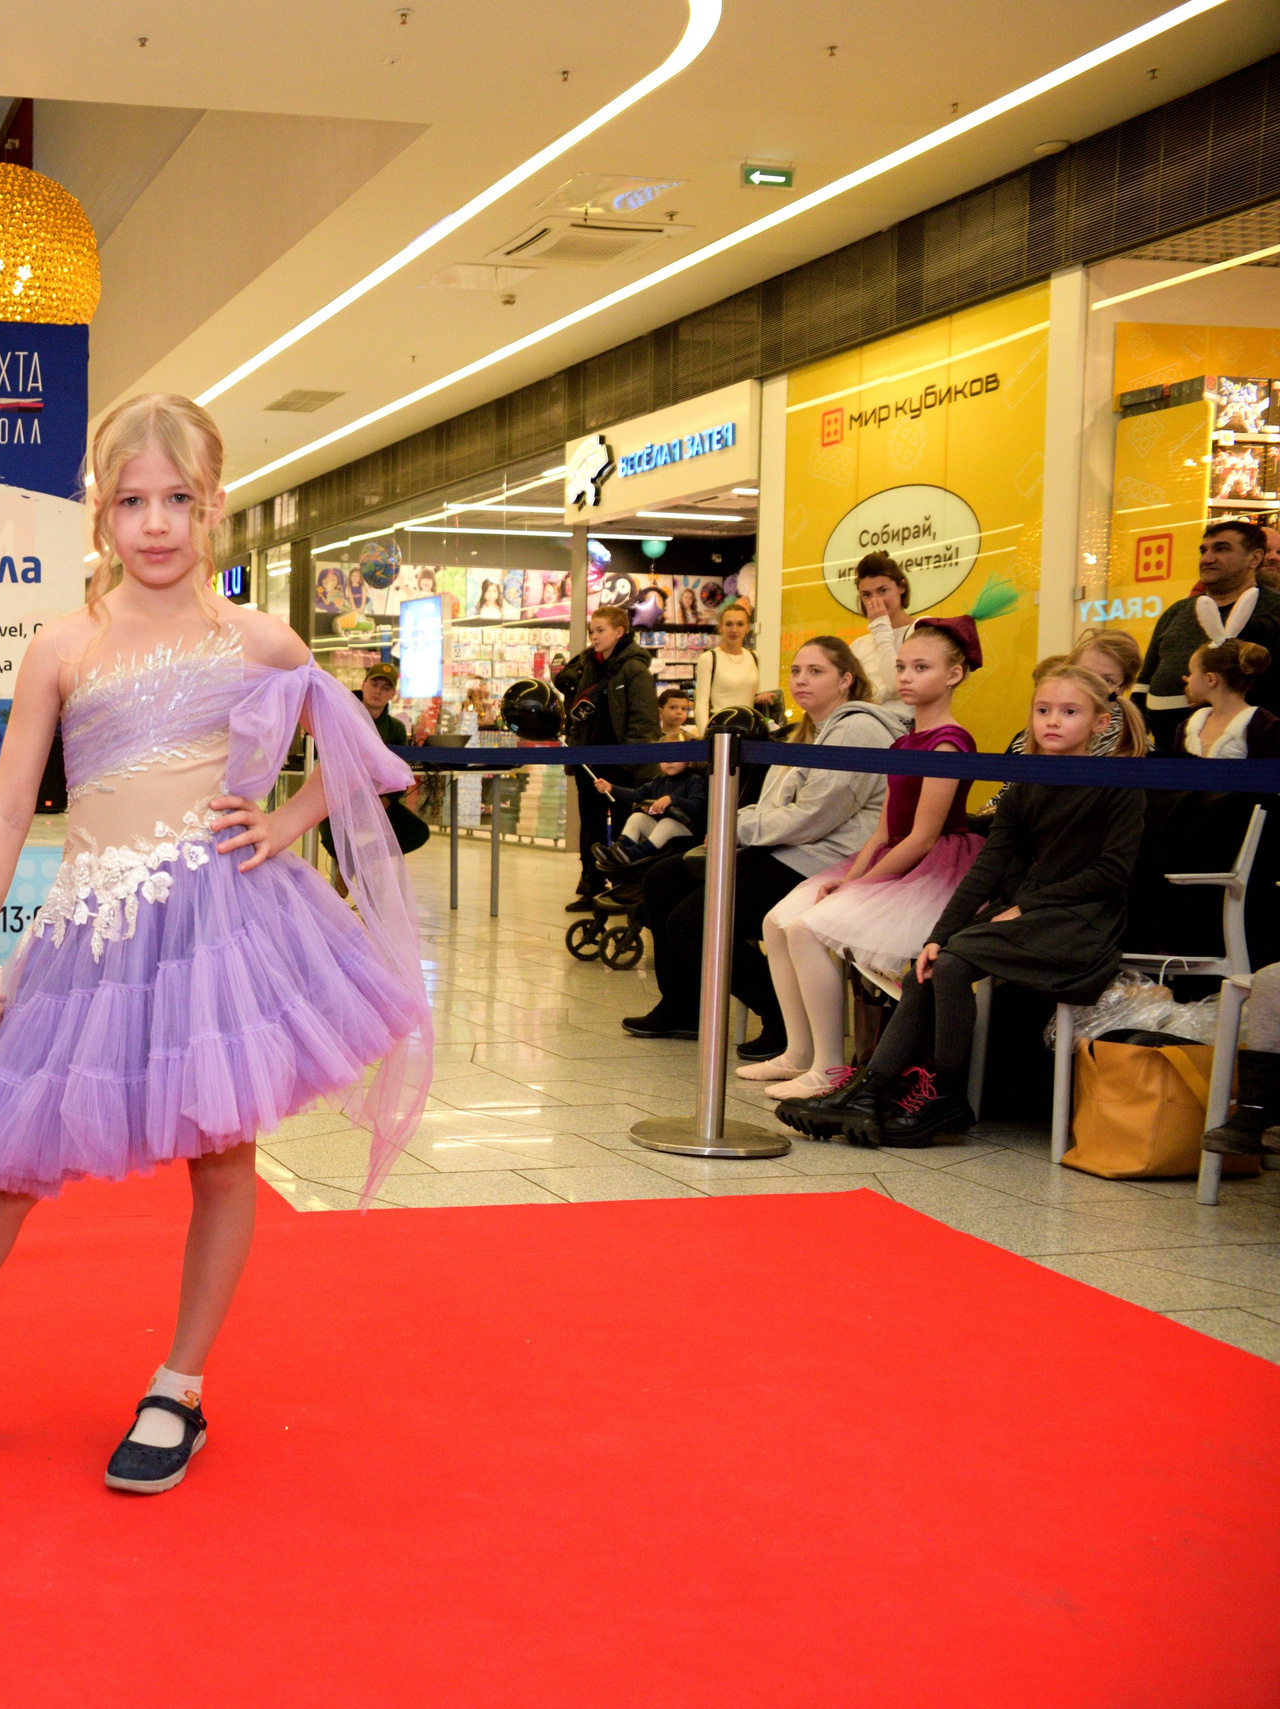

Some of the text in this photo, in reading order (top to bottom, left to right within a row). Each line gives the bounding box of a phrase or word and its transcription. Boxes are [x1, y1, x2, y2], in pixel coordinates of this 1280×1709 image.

[617, 421, 736, 479] ВЕСЁЛАЯ ЗАТЕЯ
[859, 514, 937, 548] Собирай,
